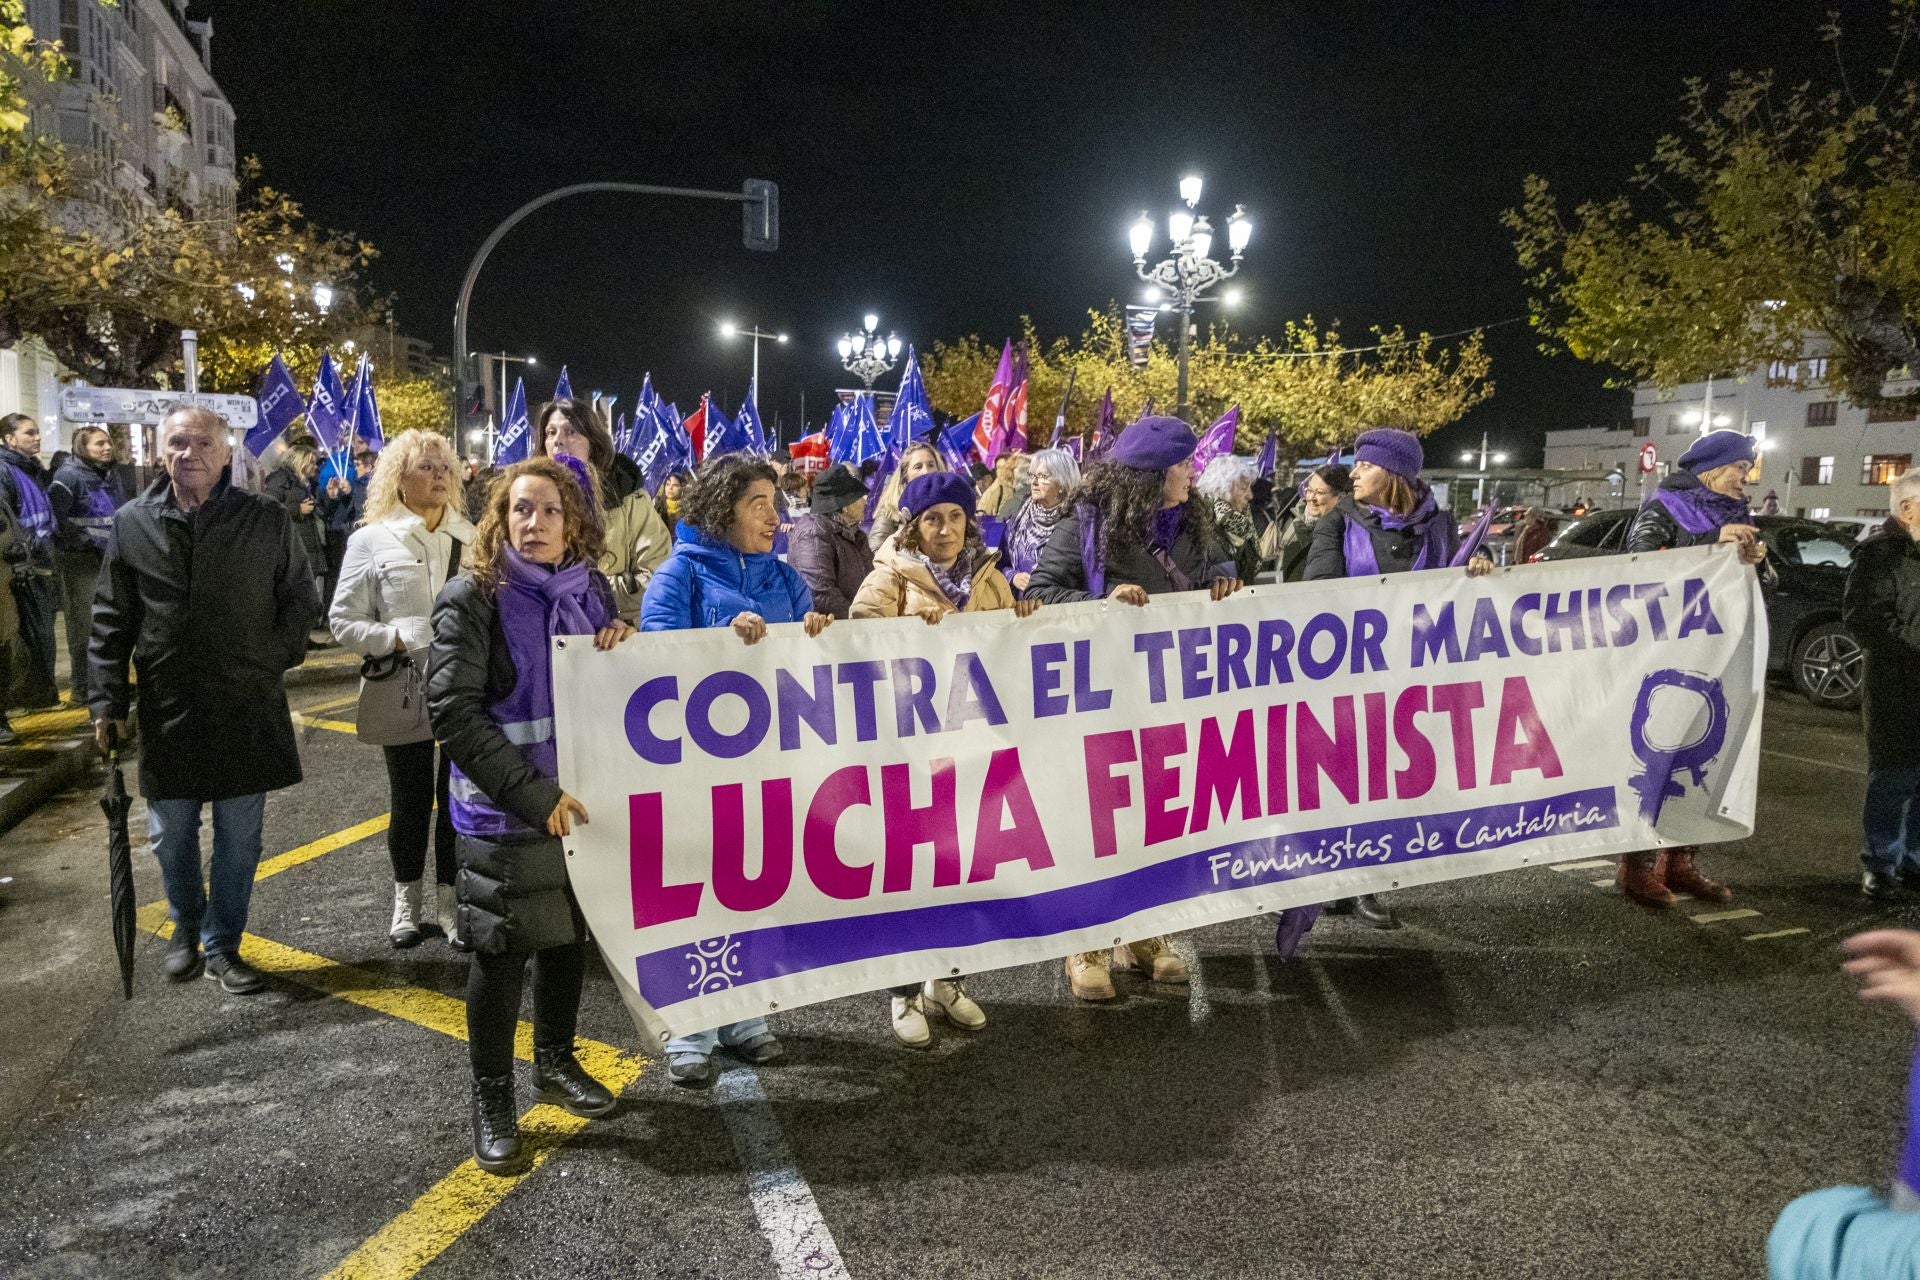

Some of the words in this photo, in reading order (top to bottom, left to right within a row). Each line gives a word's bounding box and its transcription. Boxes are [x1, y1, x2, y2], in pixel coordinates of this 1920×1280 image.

[624, 651, 1009, 765] CONTRA
[1031, 639, 1113, 718] EL
[1135, 608, 1389, 704] TERROR
[1411, 577, 1724, 668] MACHISTA
[629, 746, 1056, 930] LUCHA
[1084, 676, 1564, 859] FEMINISTA
[1209, 828, 1393, 885] Feministas
[1405, 821, 1444, 855] de
[1455, 802, 1607, 849] Cantabria
